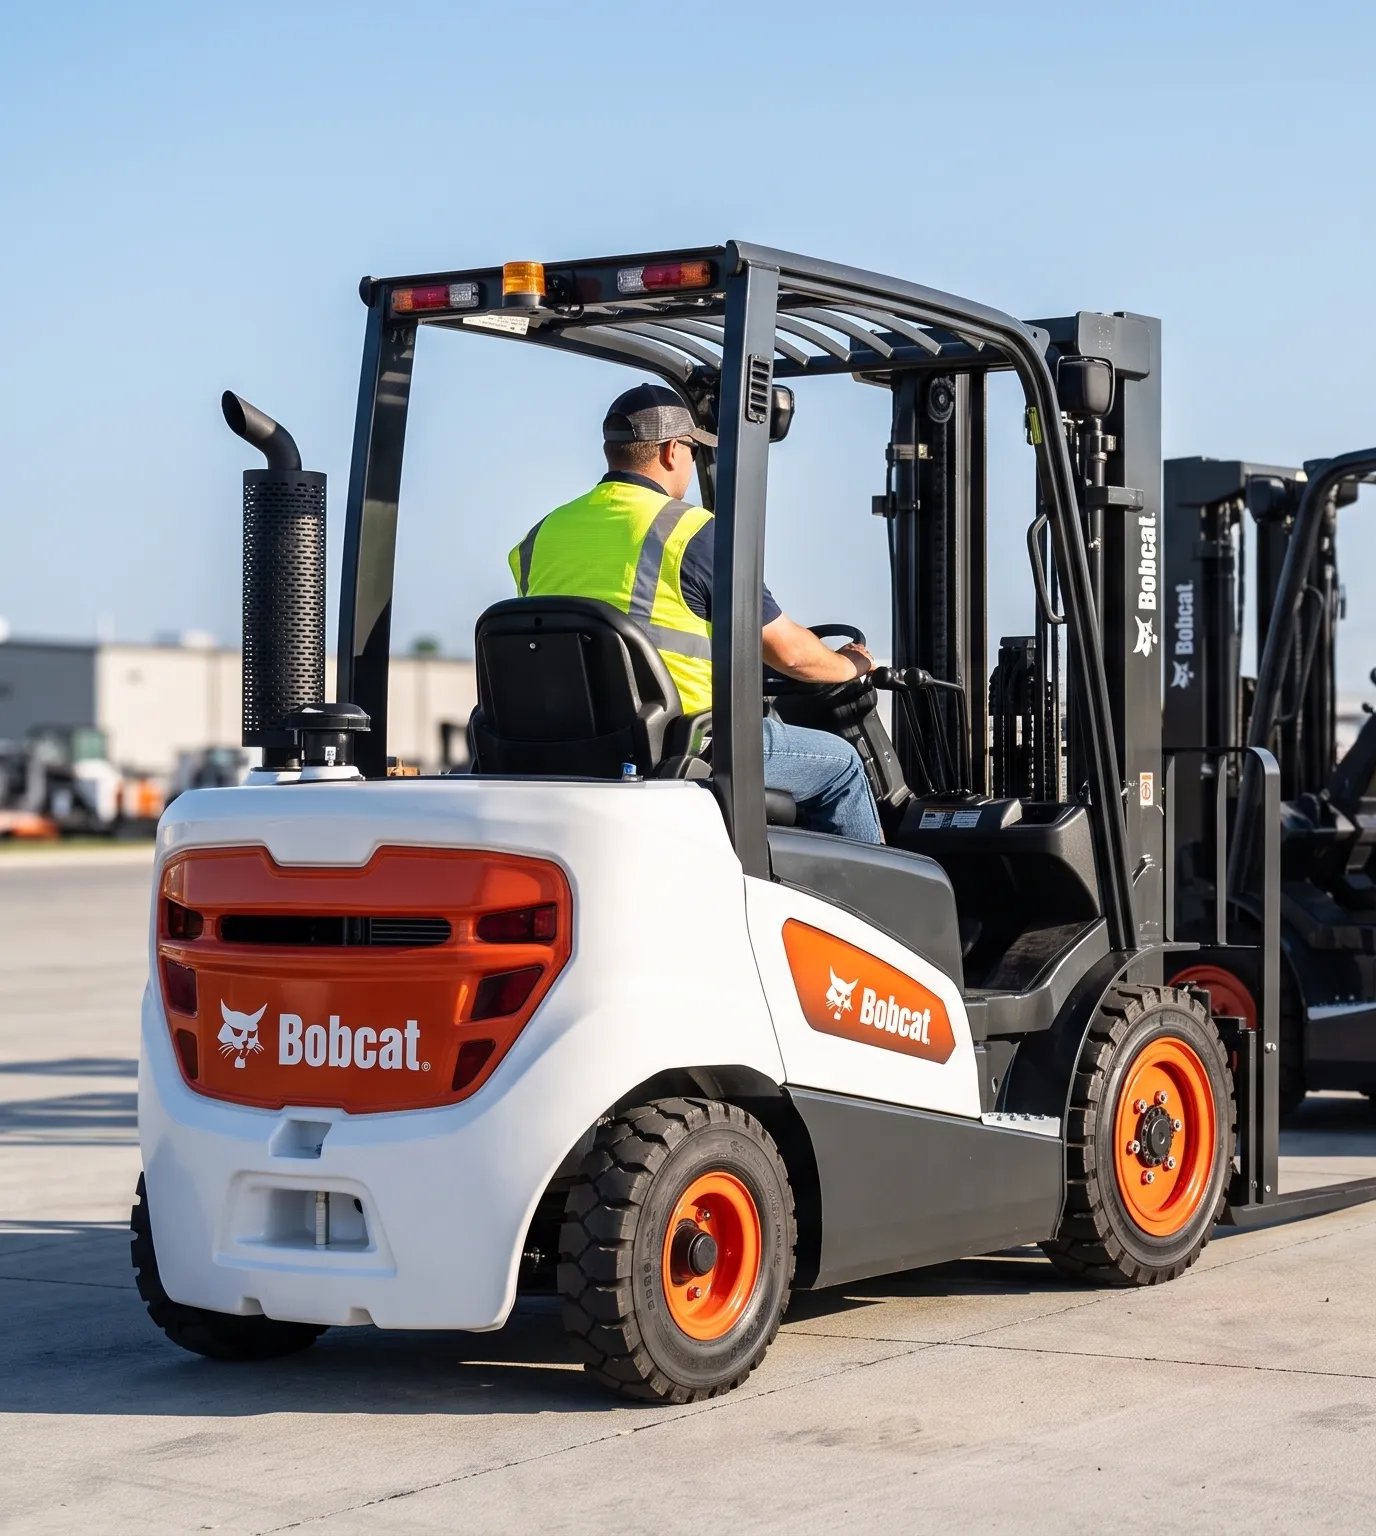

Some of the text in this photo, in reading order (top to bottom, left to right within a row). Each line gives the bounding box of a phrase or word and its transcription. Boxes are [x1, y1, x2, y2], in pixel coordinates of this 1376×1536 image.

[1138, 515, 1157, 610] Bobcat
[1175, 583, 1194, 655] Bobcat
[860, 987, 931, 1045] Bobcat
